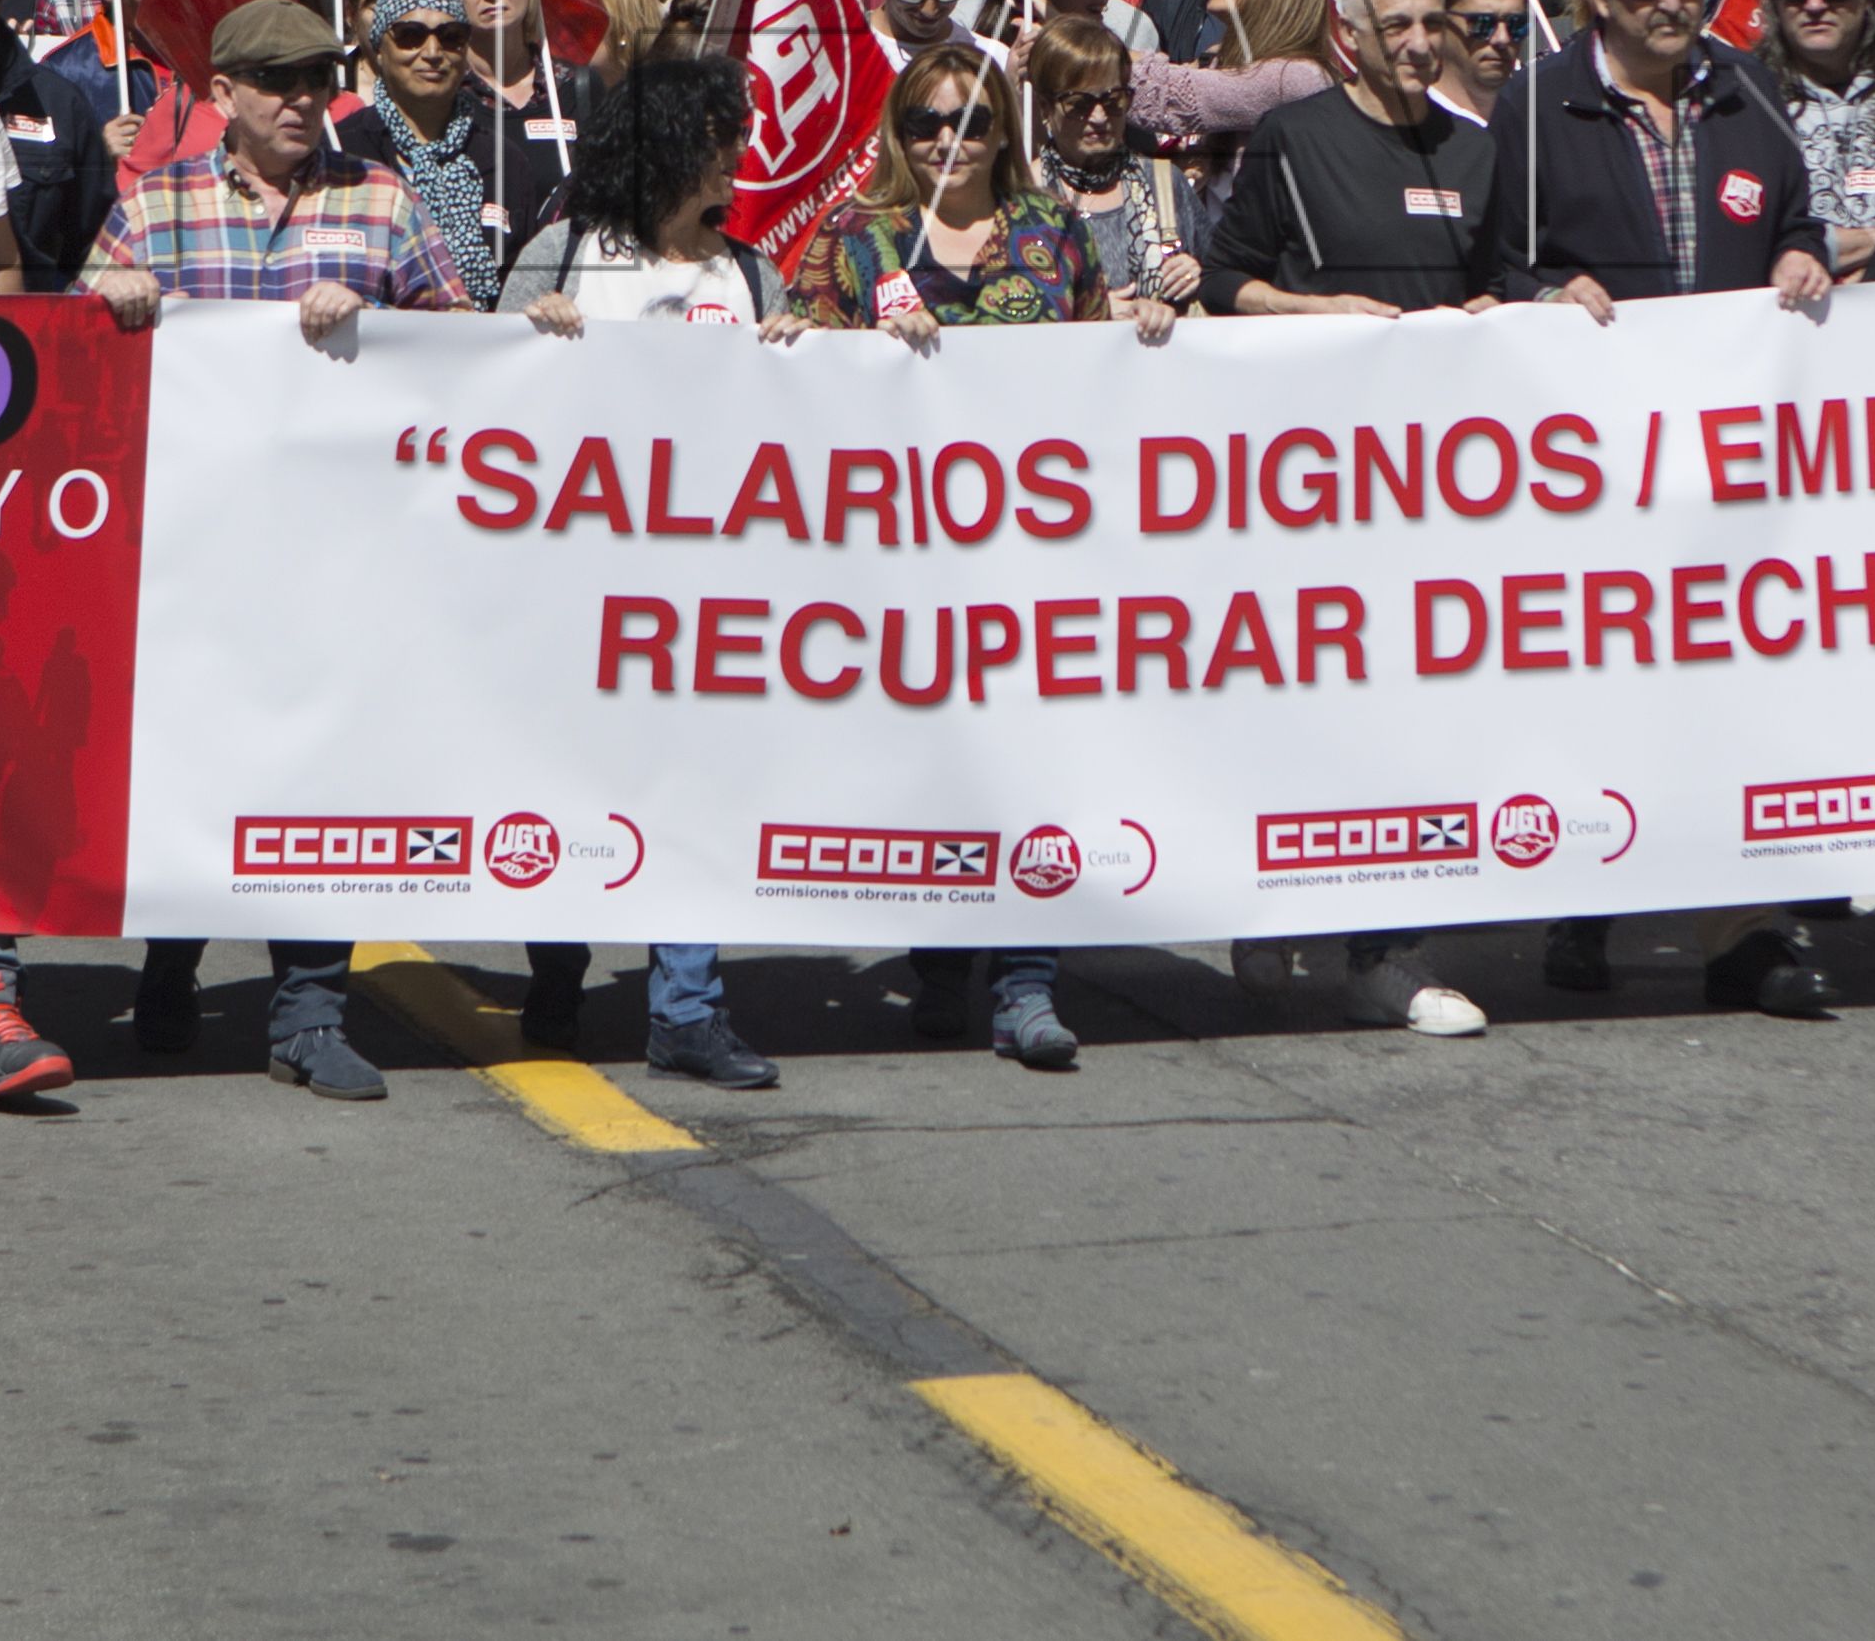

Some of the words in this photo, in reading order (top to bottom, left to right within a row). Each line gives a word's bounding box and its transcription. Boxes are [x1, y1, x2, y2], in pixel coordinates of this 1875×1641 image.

[307, 232, 345, 246] CCOO
[876, 276, 920, 307] UGT
[394, 424, 1094, 547] “SALARIOS
[1137, 412, 1604, 535] DIGNOS
[1636, 410, 1662, 508] /
[595, 584, 1368, 707] RECUPERAR
[244, 827, 399, 865] CCOO
[494, 822, 552, 857] UGT
[568, 840, 616, 860] Ceuta
[1266, 817, 1409, 860] CCOO
[1498, 805, 1553, 838] UGT
[1566, 818, 1613, 837] Ceuta
[769, 834, 925, 876] CCOO
[1022, 835, 1076, 868] UGT
[1087, 849, 1132, 868] Ceuta
[232, 879, 325, 895] comisiones
[330, 878, 393, 895] obreras
[398, 879, 418, 894] de
[423, 878, 472, 895] Ceuta
[754, 883, 849, 900] comisiones
[854, 886, 917, 903] obreras
[922, 889, 943, 903] de
[947, 889, 997, 904] Ceuta
[1257, 872, 1344, 891] comisiones
[1347, 867, 1406, 885] obreras
[1410, 865, 1430, 880] de
[1434, 862, 1480, 879] Ceuta
